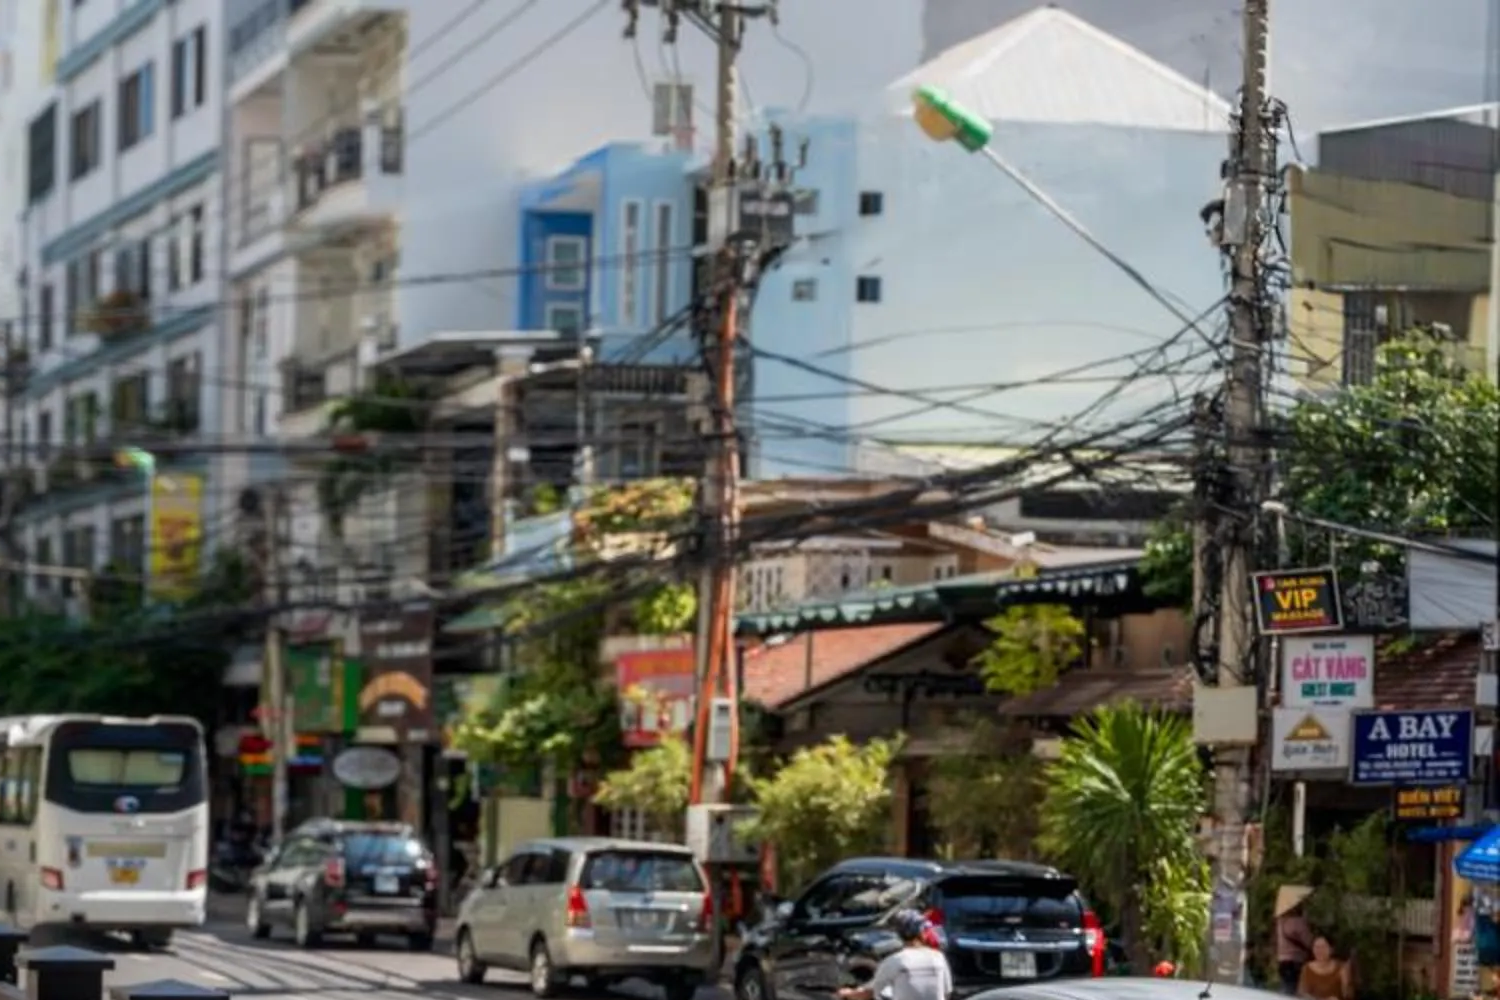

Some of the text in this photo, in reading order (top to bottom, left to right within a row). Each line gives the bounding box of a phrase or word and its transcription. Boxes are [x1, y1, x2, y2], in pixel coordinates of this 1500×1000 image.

[1275, 588, 1317, 609] VIP
[1367, 714, 1458, 740] A BAY
[1385, 742, 1438, 759] HOTEL
